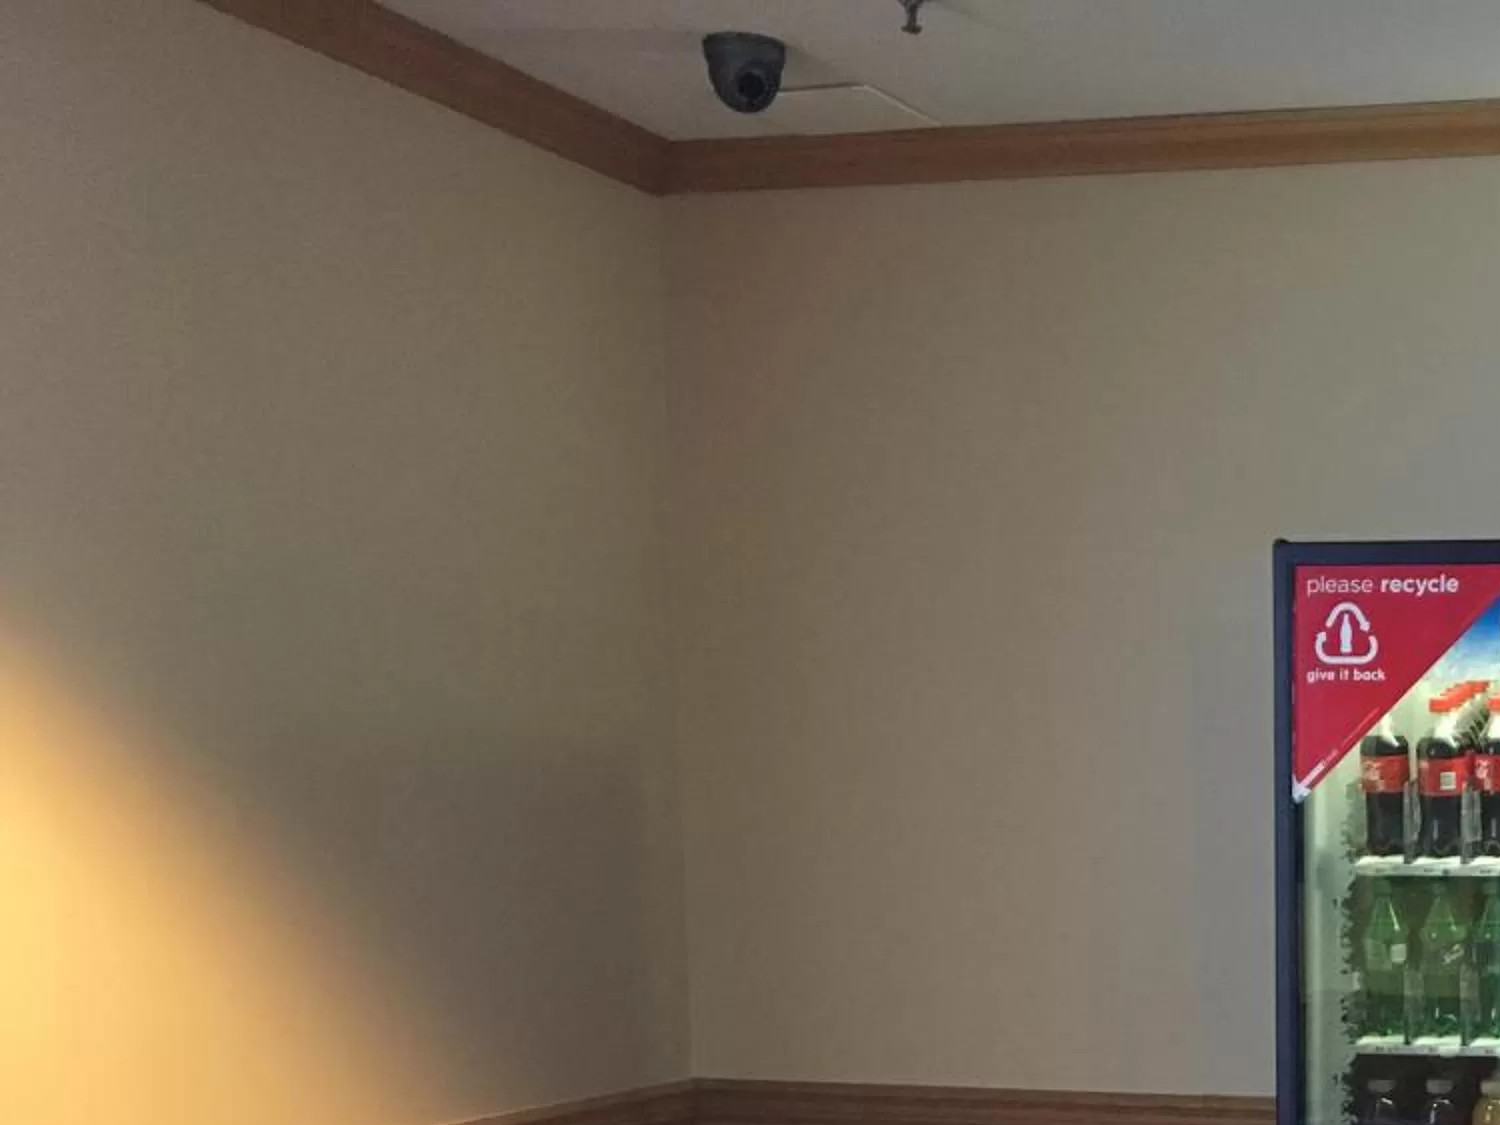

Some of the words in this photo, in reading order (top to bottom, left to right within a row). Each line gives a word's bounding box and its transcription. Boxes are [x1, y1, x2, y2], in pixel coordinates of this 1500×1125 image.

[1306, 575, 1374, 598] please
[1380, 574, 1460, 597] recycle
[1306, 669, 1336, 685] give
[1339, 668, 1350, 681] it
[1353, 668, 1386, 681] back
